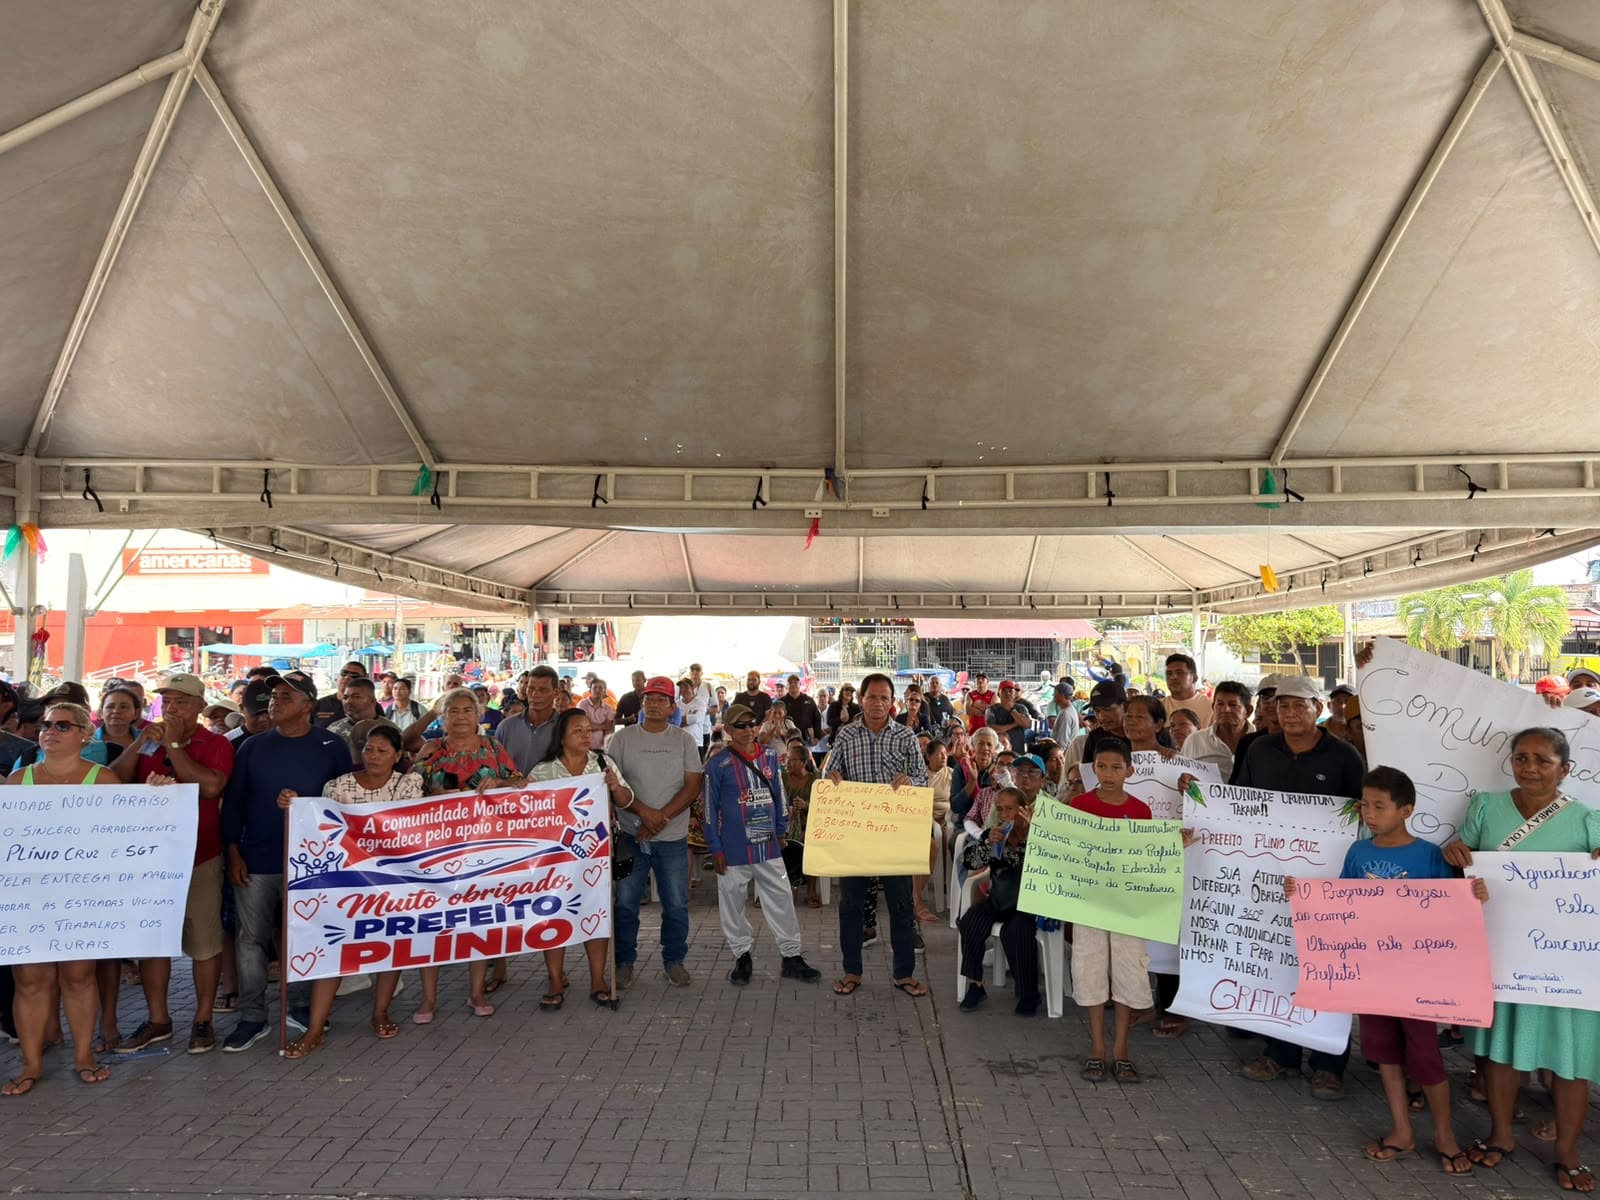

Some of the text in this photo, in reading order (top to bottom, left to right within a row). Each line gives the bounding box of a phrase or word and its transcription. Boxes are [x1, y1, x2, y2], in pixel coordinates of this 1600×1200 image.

[139, 553, 252, 570] americanas
[1136, 767, 1155, 777] KANA
[0, 801, 54, 812] NIDADE
[62, 794, 104, 809] NOVO
[1209, 784, 1275, 803] COMUNIDADE
[362, 793, 556, 834] A comunidade Monte Sinai
[1036, 801, 1047, 818] A
[21, 825, 81, 838] SINCERO
[357, 812, 568, 854] agradece pelo apoio e parceria.
[1200, 828, 1243, 846] PREFEITO
[1289, 838, 1321, 853] CRUZ
[1502, 828, 1527, 848] LOLA
[6, 843, 60, 863] PLÍNIO
[125, 845, 160, 858] SGT
[40, 873, 111, 886] ENTREGA
[118, 873, 135, 882] DA
[1216, 866, 1286, 886] SUA ATITUD
[336, 866, 574, 919] Muito obrigado,
[1251, 883, 1290, 904] OBRIGAD
[42, 902, 57, 911] AS
[64, 899, 125, 910] ESTRADAS
[0, 924, 18, 935] ER
[29, 923, 46, 934] OS
[139, 919, 163, 929] DOS
[353, 895, 563, 940] PREFEITO
[1190, 915, 1292, 946] NOSSA COMUNIDADE
[0, 938, 110, 956] ORES RURAIS
[339, 917, 574, 975] PLÍNIO
[1190, 930, 1229, 953] TAKANA
[1235, 941, 1244, 955] E
[1249, 942, 1275, 962] PARA
